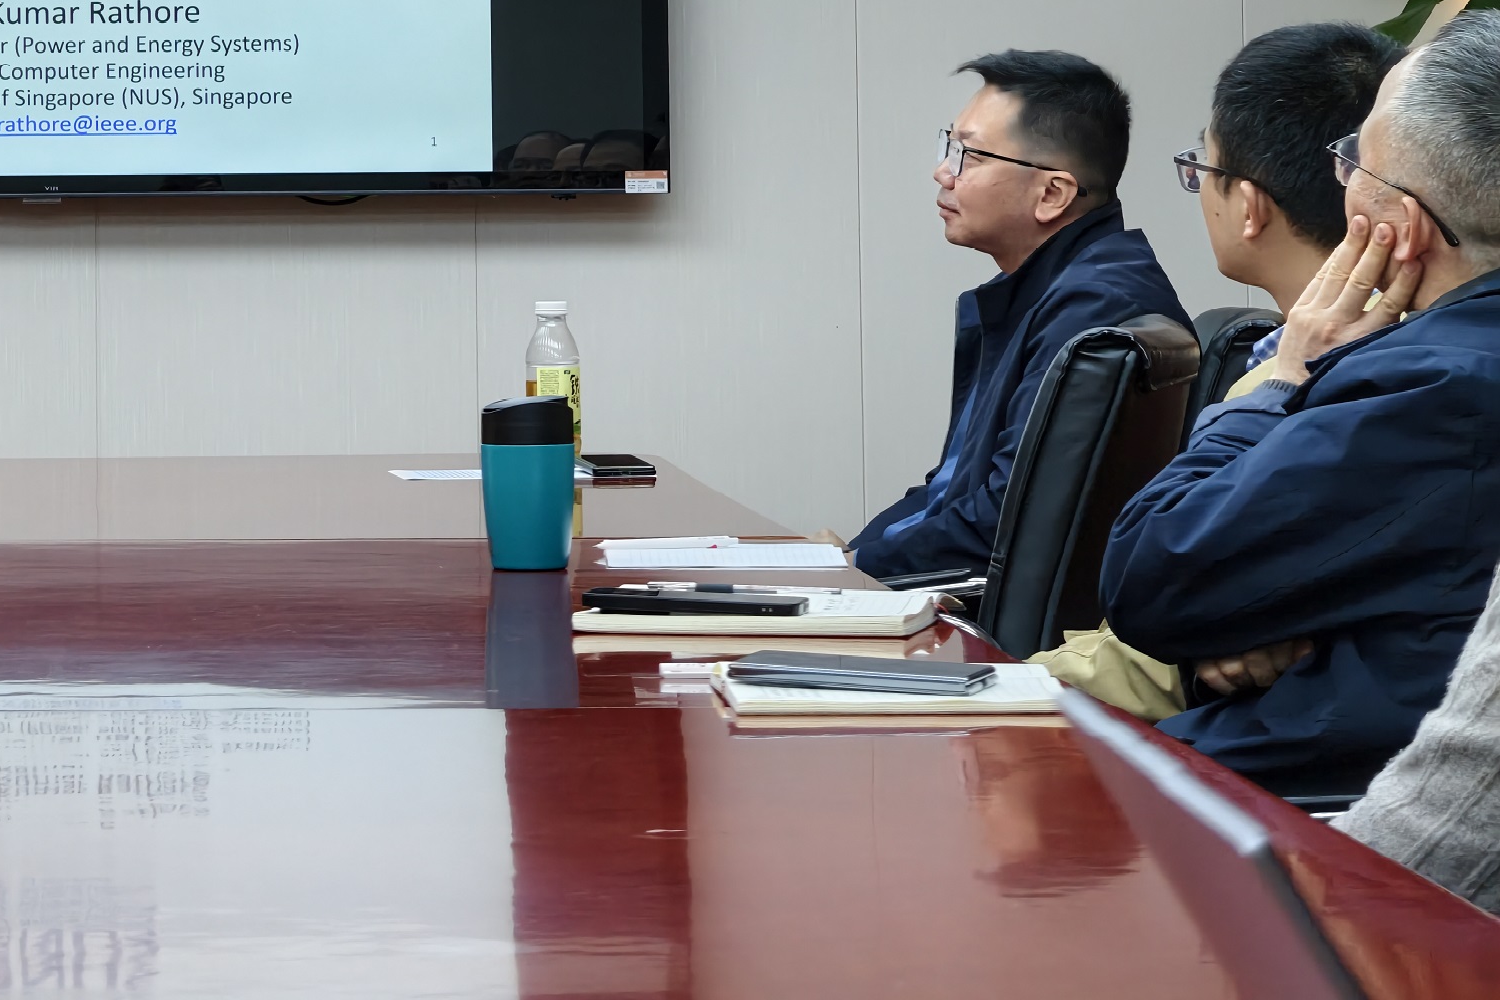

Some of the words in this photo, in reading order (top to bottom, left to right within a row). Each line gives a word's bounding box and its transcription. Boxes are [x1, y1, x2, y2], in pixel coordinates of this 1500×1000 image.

[89, 0, 200, 25] Rathore
[14, 35, 86, 58] (Power
[91, 35, 129, 54] and
[136, 35, 205, 58] Energy
[210, 34, 300, 57] Systems)
[106, 62, 226, 84] Engineering
[14, 89, 115, 112] Singapore
[121, 86, 186, 110] (NUS),
[192, 87, 293, 110] Singapore
[430, 136, 438, 147] 1
